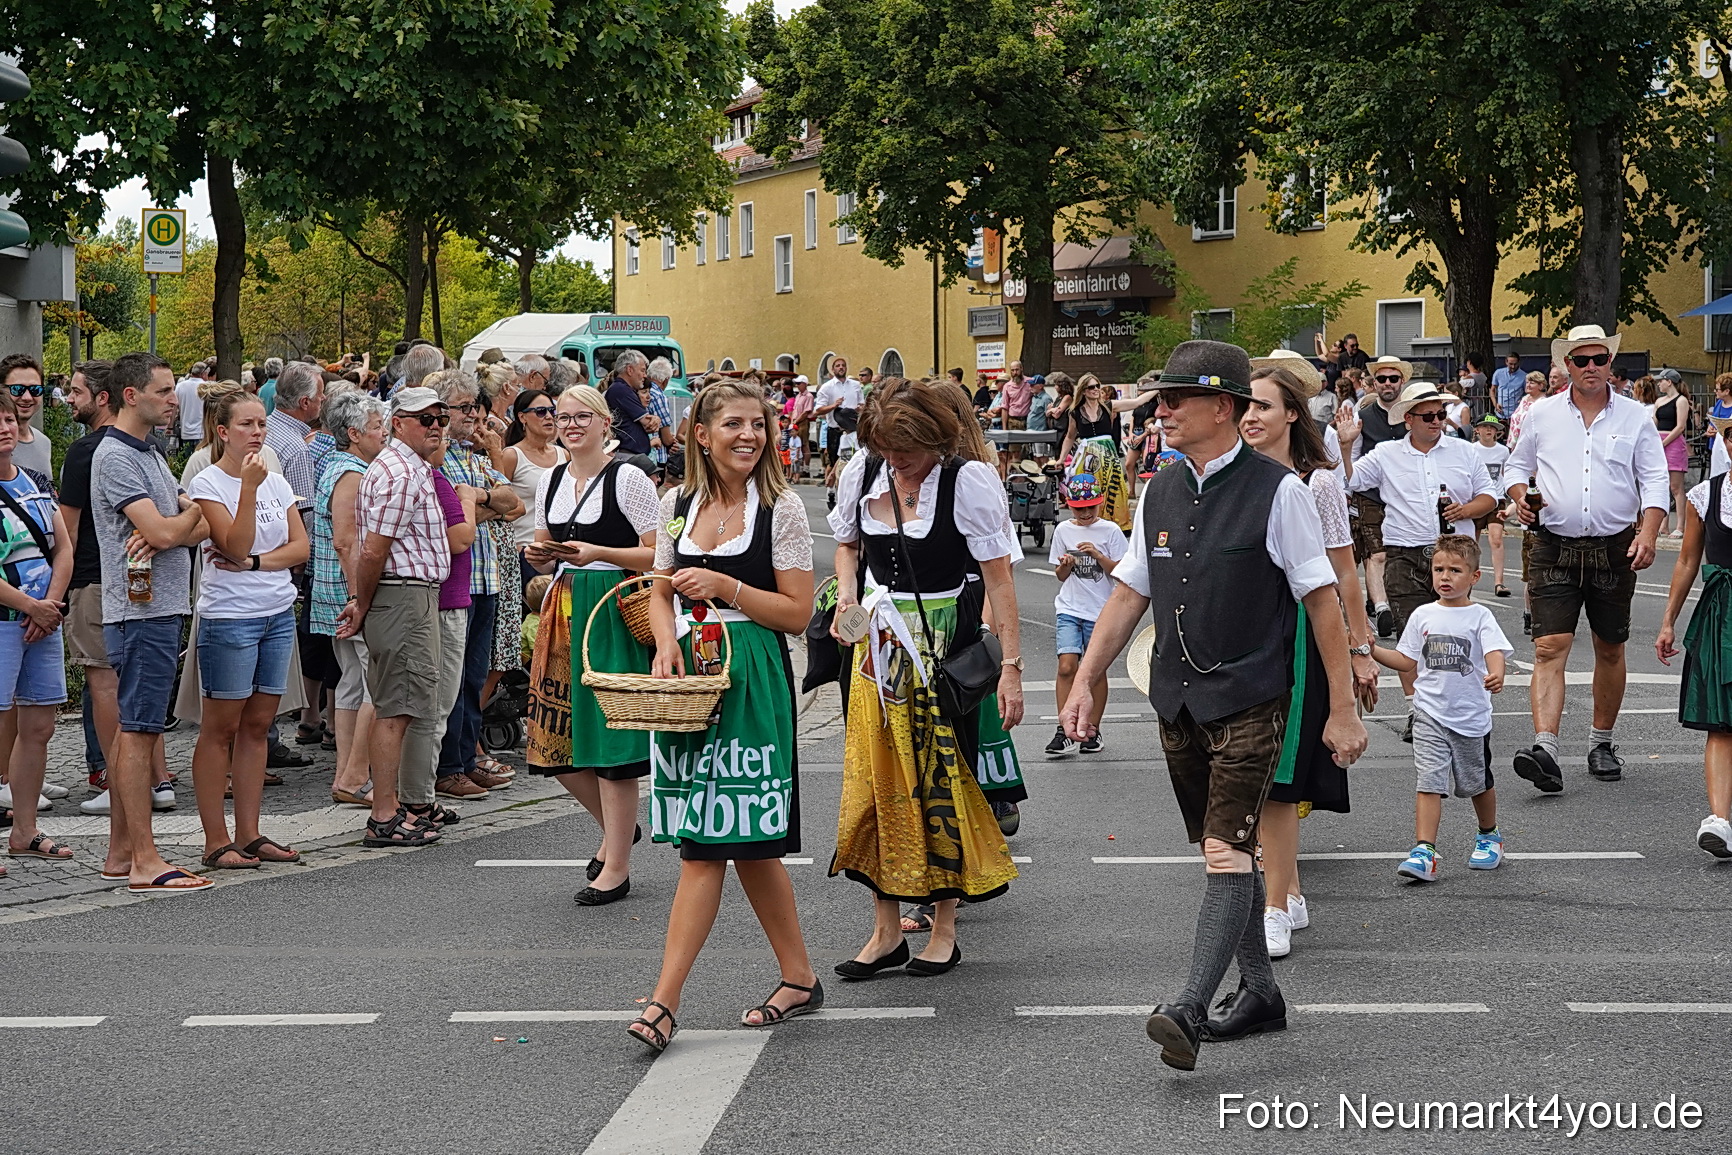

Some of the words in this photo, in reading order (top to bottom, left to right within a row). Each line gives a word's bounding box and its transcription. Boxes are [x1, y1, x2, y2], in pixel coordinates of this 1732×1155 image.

[597, 318, 663, 332] LAMMSBRÄU
[1052, 324, 1080, 339] sfahrt
[1083, 323, 1100, 339] Tag
[1063, 341, 1113, 356] freihalten!
